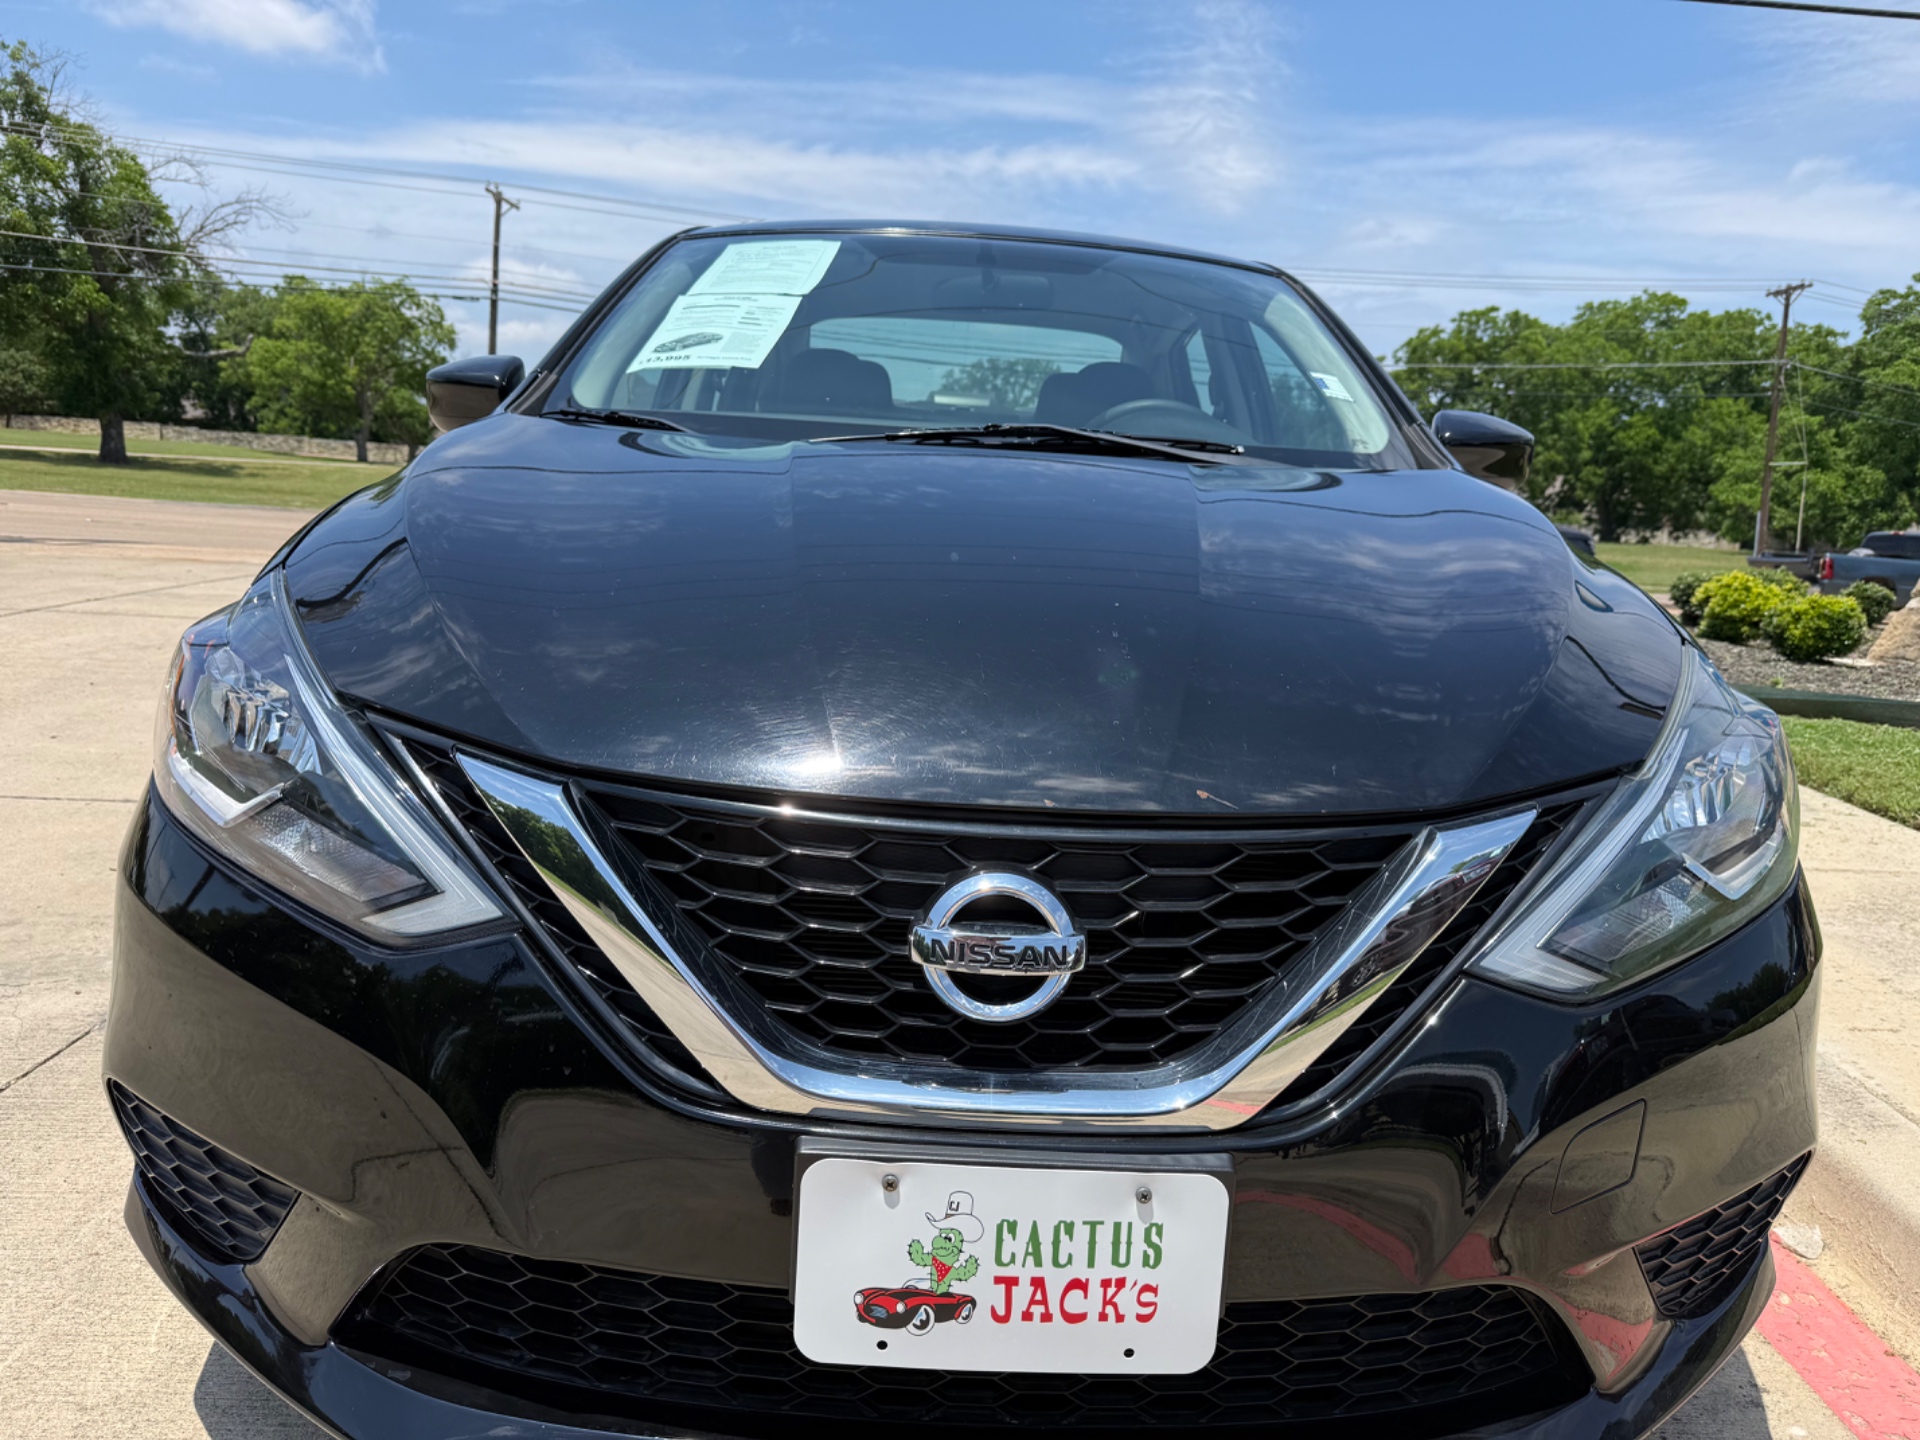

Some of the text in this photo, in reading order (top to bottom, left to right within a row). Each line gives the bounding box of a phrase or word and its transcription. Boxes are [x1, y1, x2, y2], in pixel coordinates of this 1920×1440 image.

[930, 938, 1067, 967] NISSAN
[996, 1220, 1162, 1268] CACTUS
[991, 1276, 1158, 1324] JACK'S
